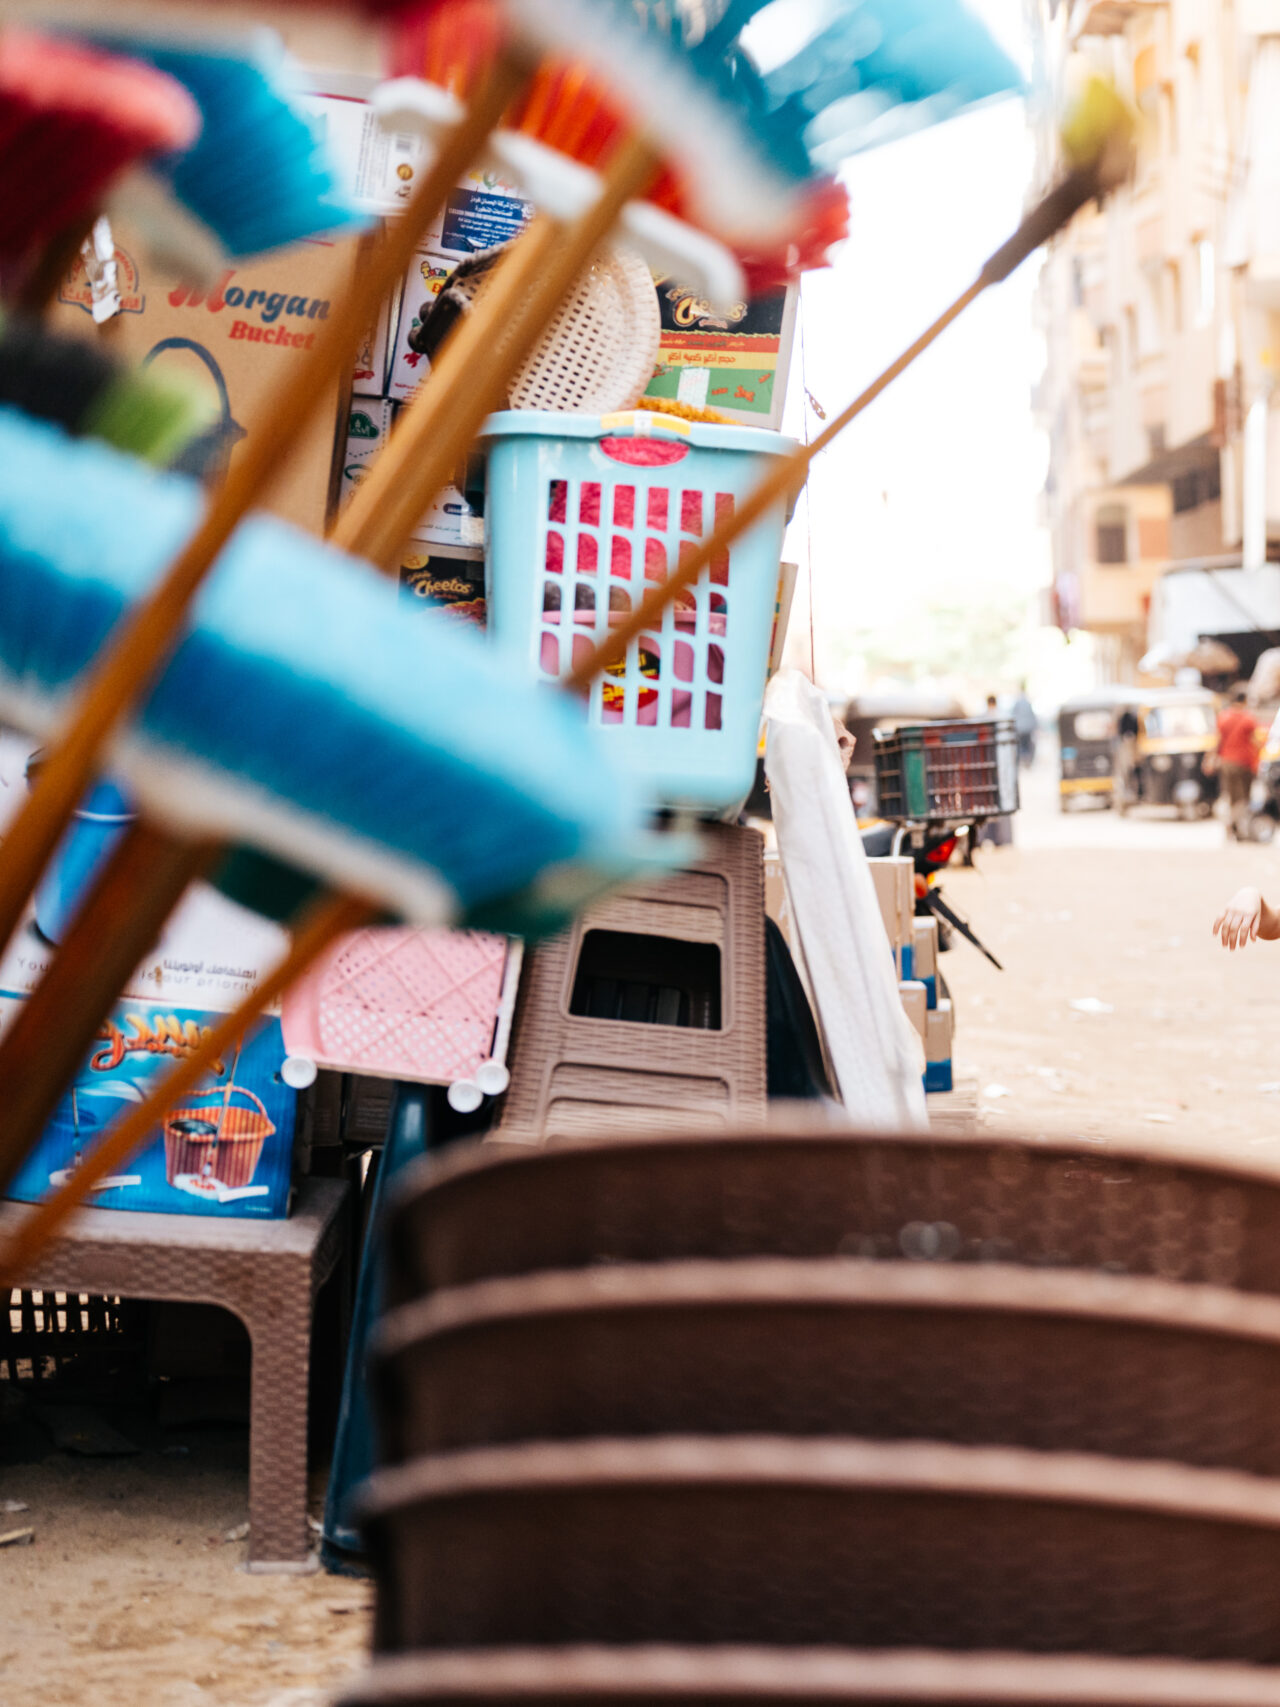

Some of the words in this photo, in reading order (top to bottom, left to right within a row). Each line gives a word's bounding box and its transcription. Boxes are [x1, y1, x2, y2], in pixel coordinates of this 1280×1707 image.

[168, 270, 331, 323] Morgan
[228, 320, 317, 350] Bucket
[414, 577, 471, 597] Cheetos
